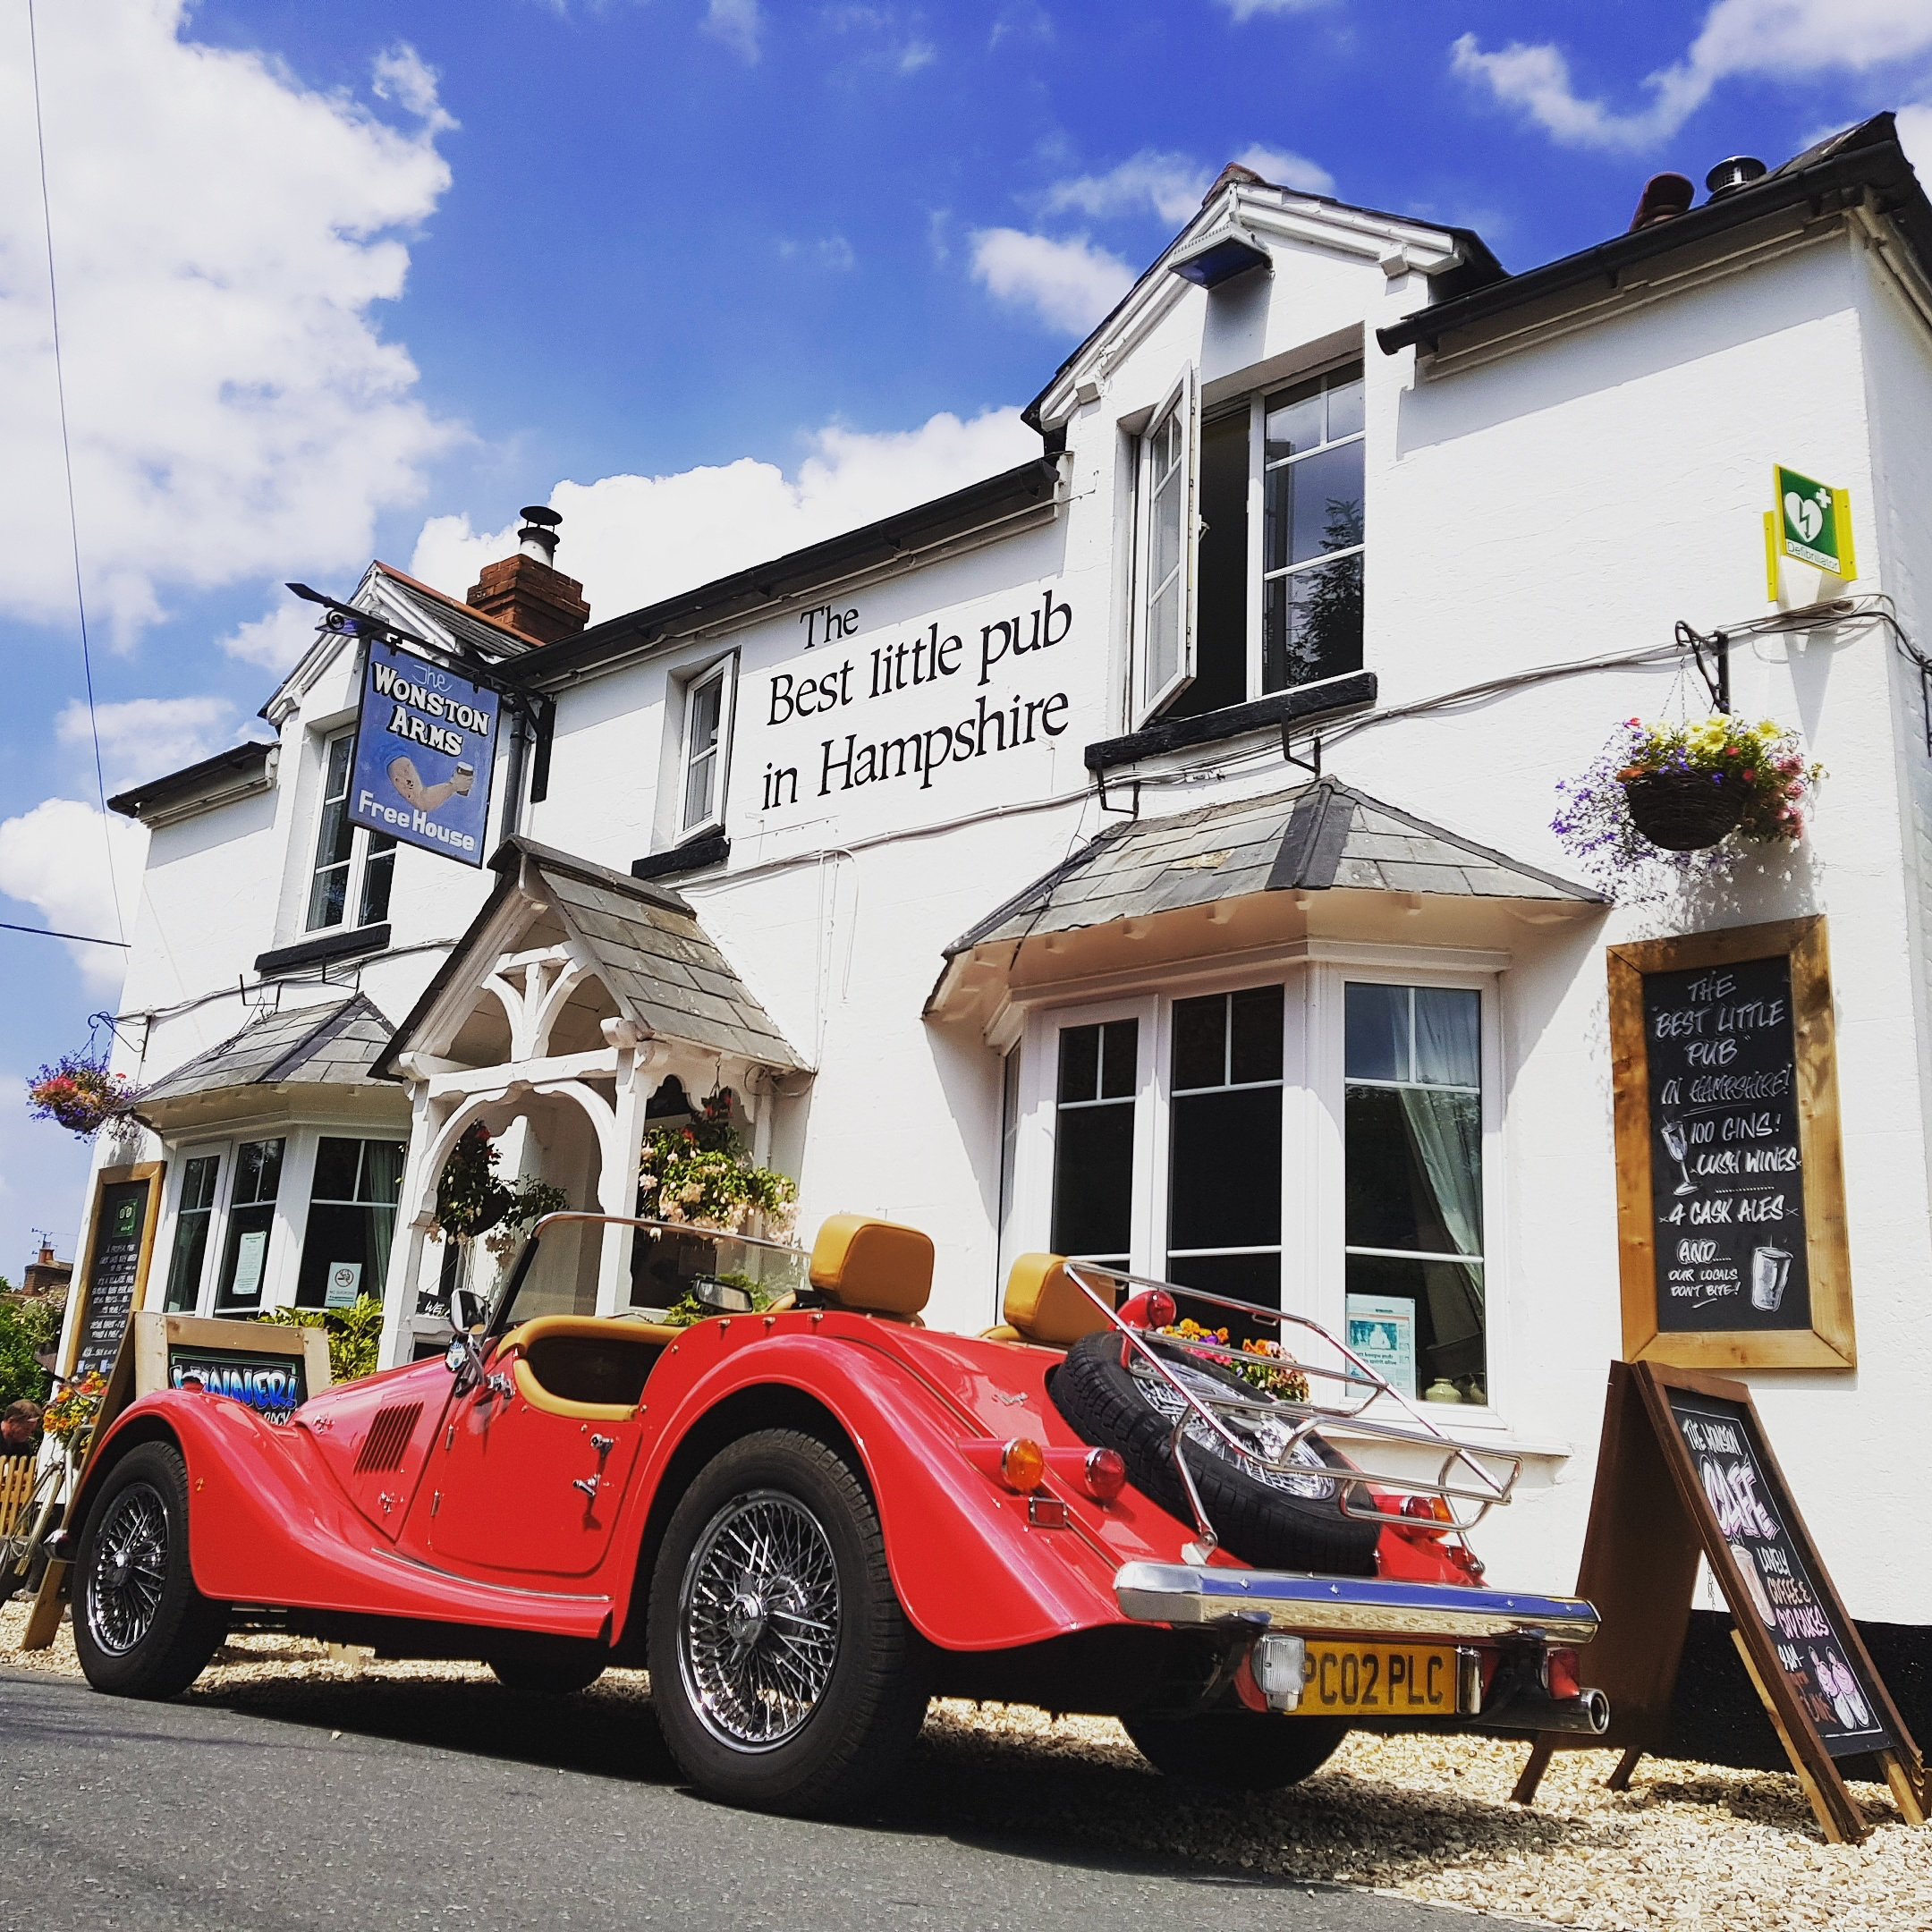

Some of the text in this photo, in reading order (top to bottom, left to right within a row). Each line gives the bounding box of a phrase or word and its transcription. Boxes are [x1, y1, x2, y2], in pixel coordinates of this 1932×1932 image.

[1786, 541, 1838, 570] Defibrillator
[799, 604, 860, 650] The
[767, 589, 1072, 725] Best little pub
[411, 664, 453, 691] The
[371, 661, 490, 736] WONSTON
[386, 705, 463, 758] ARMS
[761, 691, 1069, 811] in Hampshire
[1687, 970, 1737, 1002] THE
[1716, 999, 1785, 1034] LITTLE
[1661, 1077, 1683, 1105] IN
[1690, 1121, 1715, 1145] 100
[1746, 1146, 1797, 1173] WINES
[1690, 1199, 1733, 1225] CASK
[1738, 1195, 1785, 1223] ALES
[1699, 1453, 1780, 1541] CAFE
[1388, 1654, 1445, 1706] PLC
